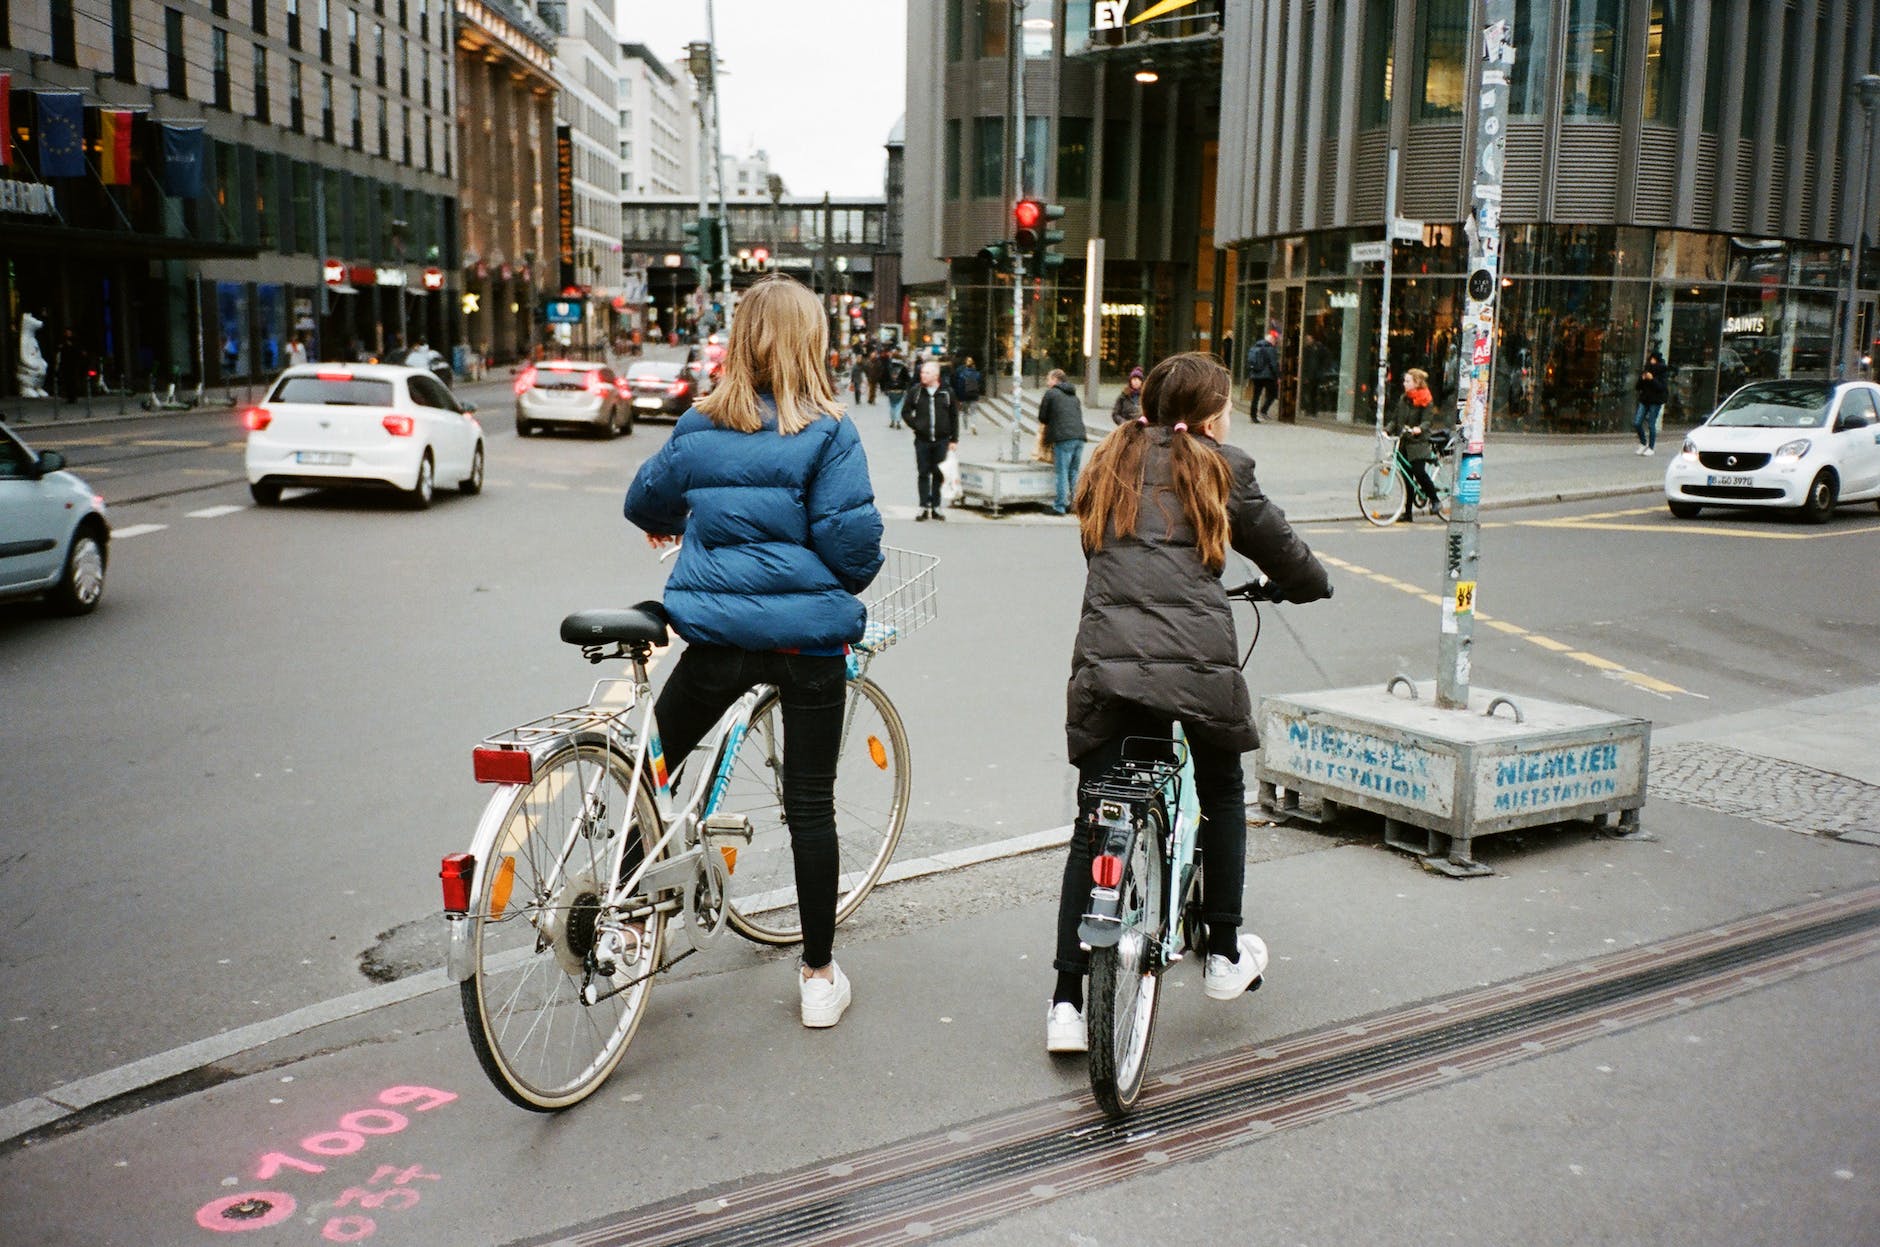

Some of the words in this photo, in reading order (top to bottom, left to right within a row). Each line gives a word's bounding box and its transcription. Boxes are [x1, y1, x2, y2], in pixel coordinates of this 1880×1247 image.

[1095, 0, 1129, 30] EY
[1495, 778, 1615, 809] MIETSTATION
[256, 1085, 459, 1180] 1009
